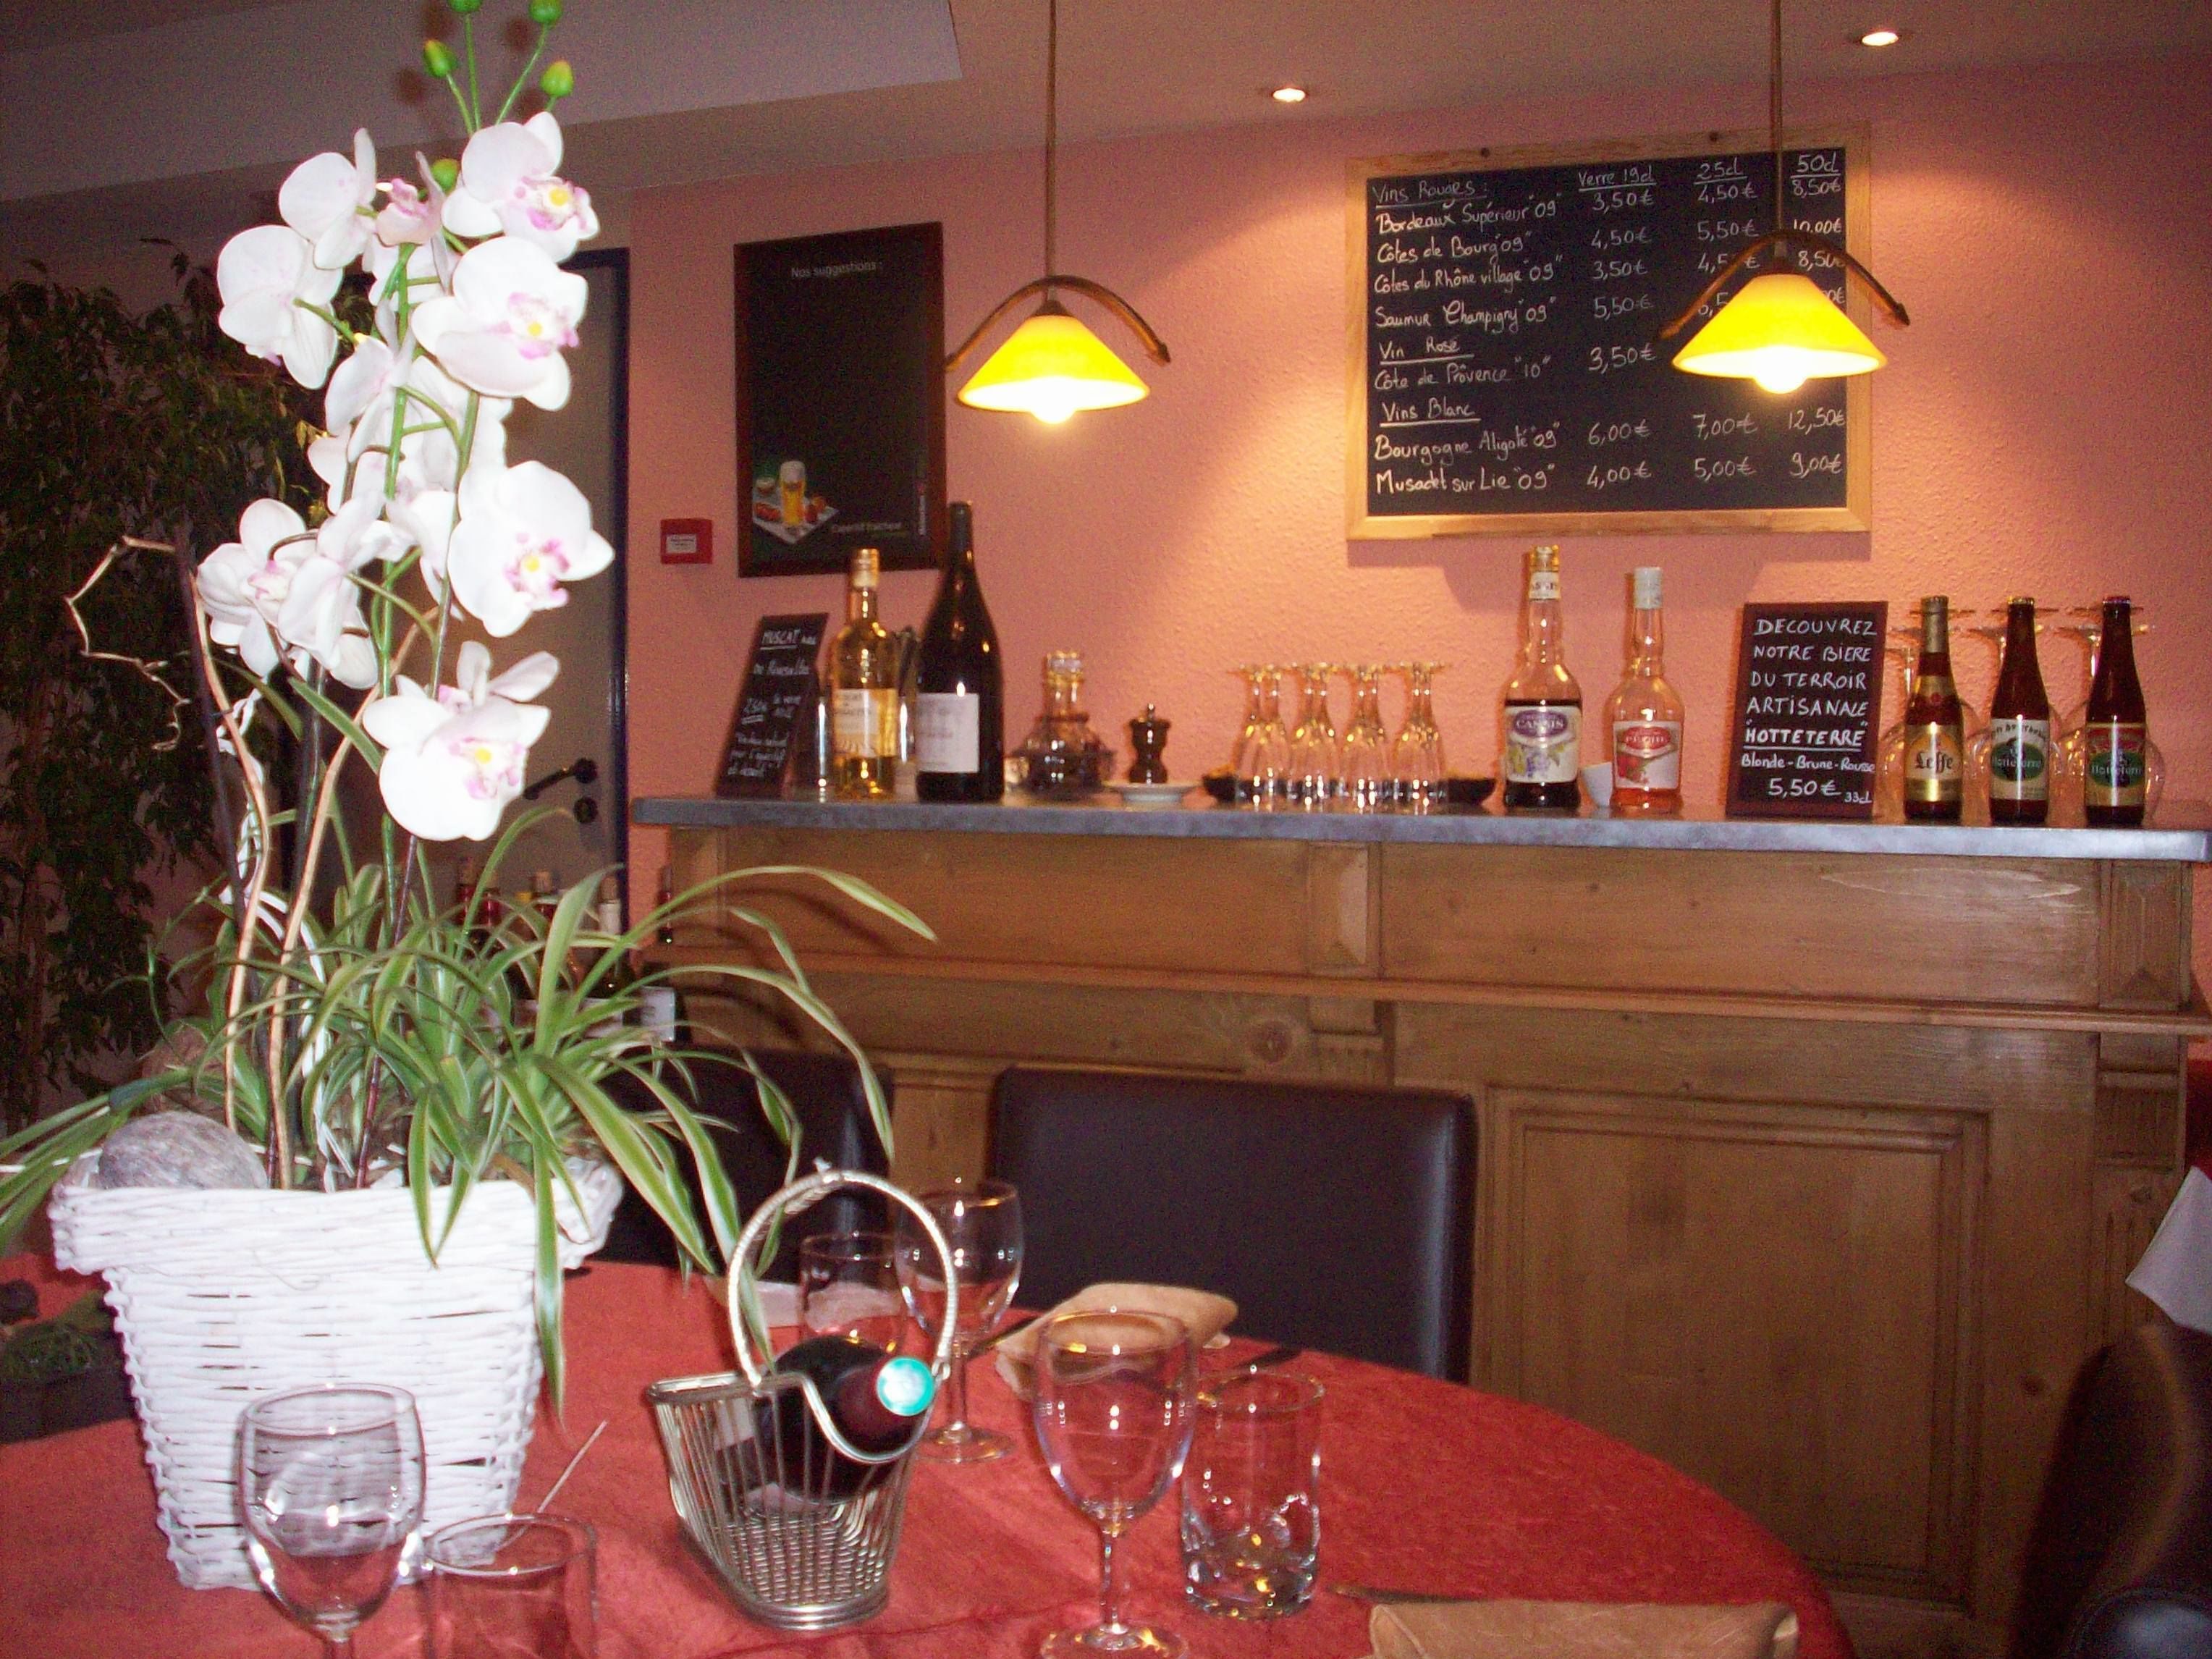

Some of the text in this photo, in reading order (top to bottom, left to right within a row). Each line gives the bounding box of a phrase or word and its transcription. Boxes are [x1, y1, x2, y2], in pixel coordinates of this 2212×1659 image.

[1372, 185, 1409, 203] Vins
[1418, 180, 1475, 208] Rouges
[1579, 171, 1616, 185] Verre
[1376, 212, 1456, 235] Bordeaux
[1462, 201, 1529, 232] Supérieur
[1377, 238, 1418, 264] Côtes
[1423, 235, 1443, 257] de
[1451, 235, 1499, 265] Bourg
[790, 266, 811, 278] Nos
[1374, 268, 1410, 294] Côtes
[1414, 268, 1431, 290] du
[1435, 267, 1477, 288] Rhône
[1481, 264, 1522, 294] village
[1375, 306, 1432, 328] Saumur
[1443, 299, 1519, 334] Champigny
[1380, 335, 1461, 360] Vin Rosé
[1374, 367, 1410, 390] Côte
[1418, 366, 1440, 386] de
[1381, 395, 1475, 422] Vins Blanc
[1375, 434, 1472, 466] Bourgogne
[1478, 425, 1529, 461] Aligoté
[1451, 479, 1475, 493] sur
[1479, 466, 1511, 491] Lie
[1754, 617, 1878, 636] DECOUVREZ
[1753, 644, 1815, 661] NOTRE
[1750, 670, 1776, 687] DU
[1915, 751, 1954, 774] Leffe
